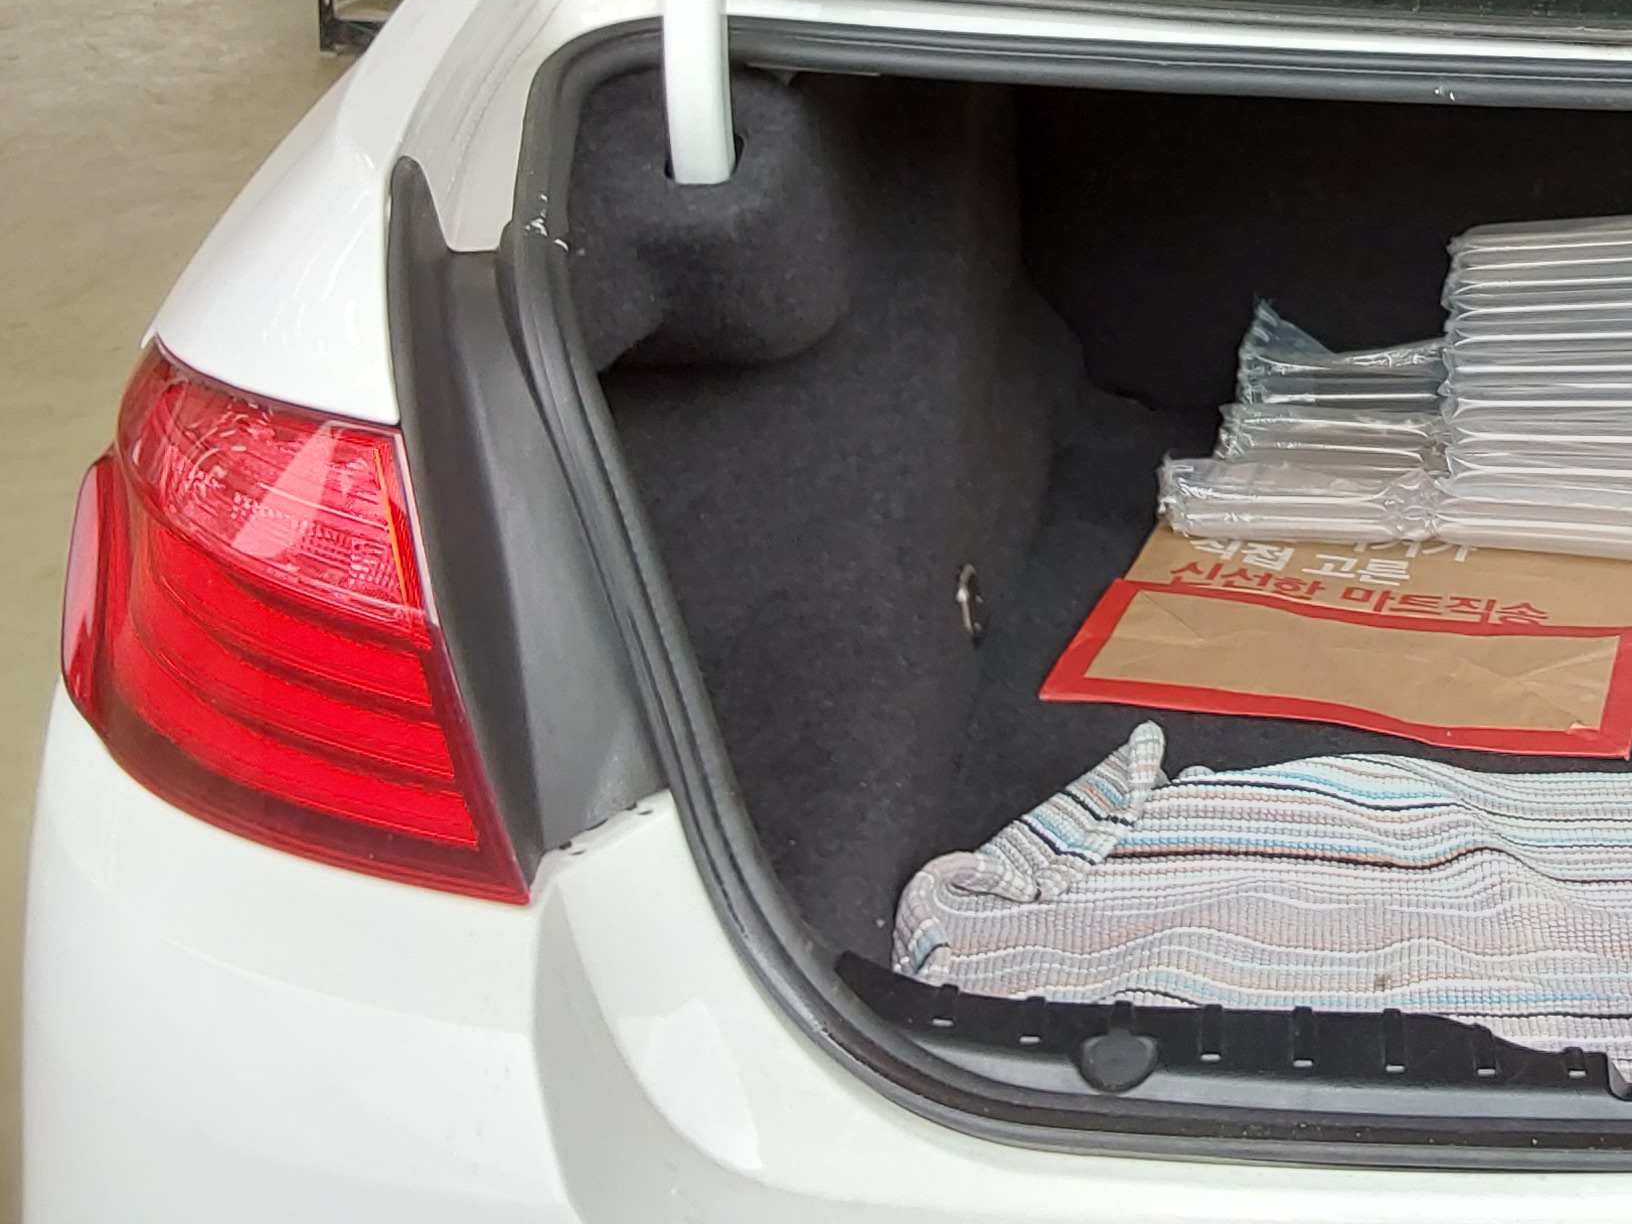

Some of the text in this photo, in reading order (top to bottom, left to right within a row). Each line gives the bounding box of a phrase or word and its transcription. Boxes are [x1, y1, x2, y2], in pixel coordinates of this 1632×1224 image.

[1169, 561, 1549, 626] 신선한 마트직송
[1302, 554, 1411, 587] 고른
